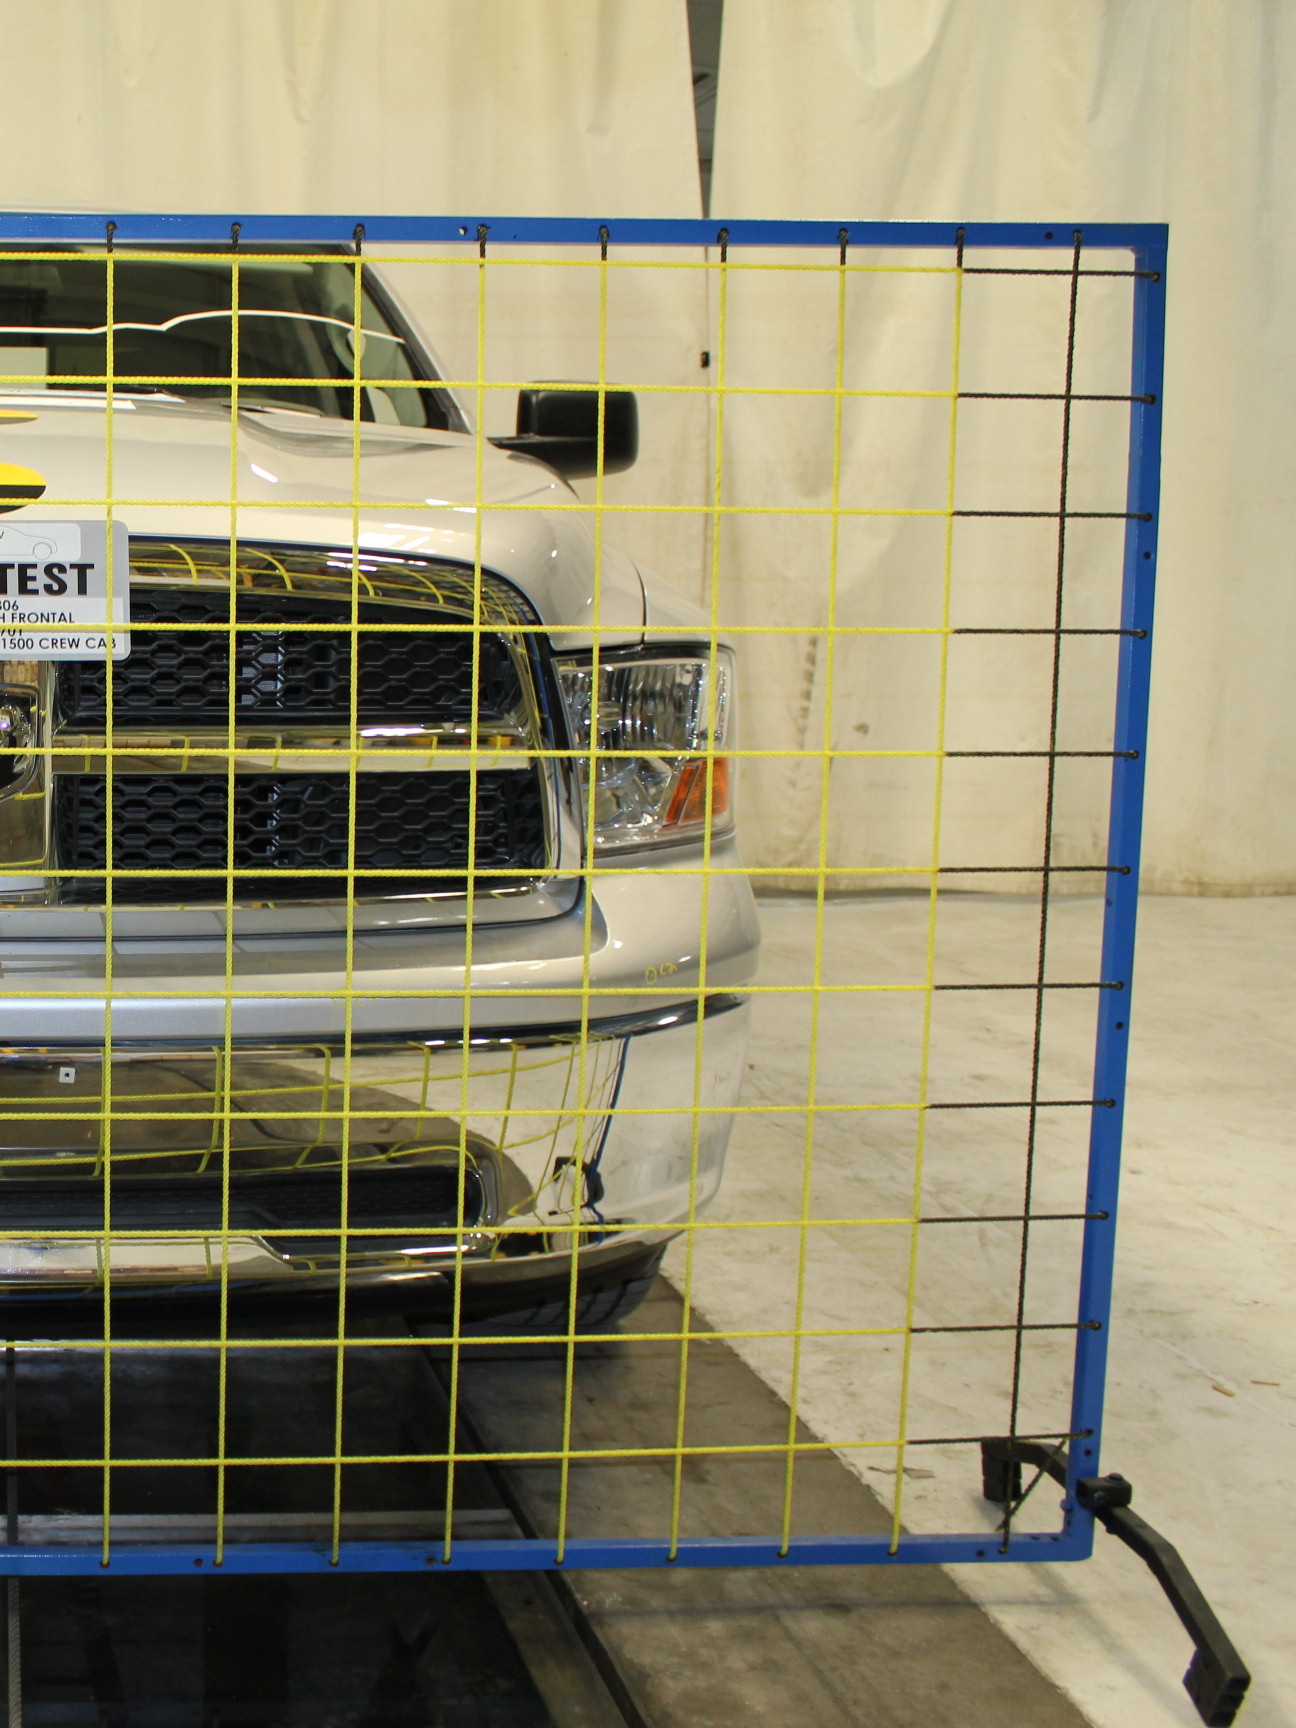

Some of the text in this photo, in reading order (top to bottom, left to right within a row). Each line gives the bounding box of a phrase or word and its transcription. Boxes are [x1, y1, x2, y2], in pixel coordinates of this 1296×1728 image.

[12, 611, 75, 624] FRONTAL
[2, 637, 34, 650] 1500
[39, 637, 81, 650] CREW
